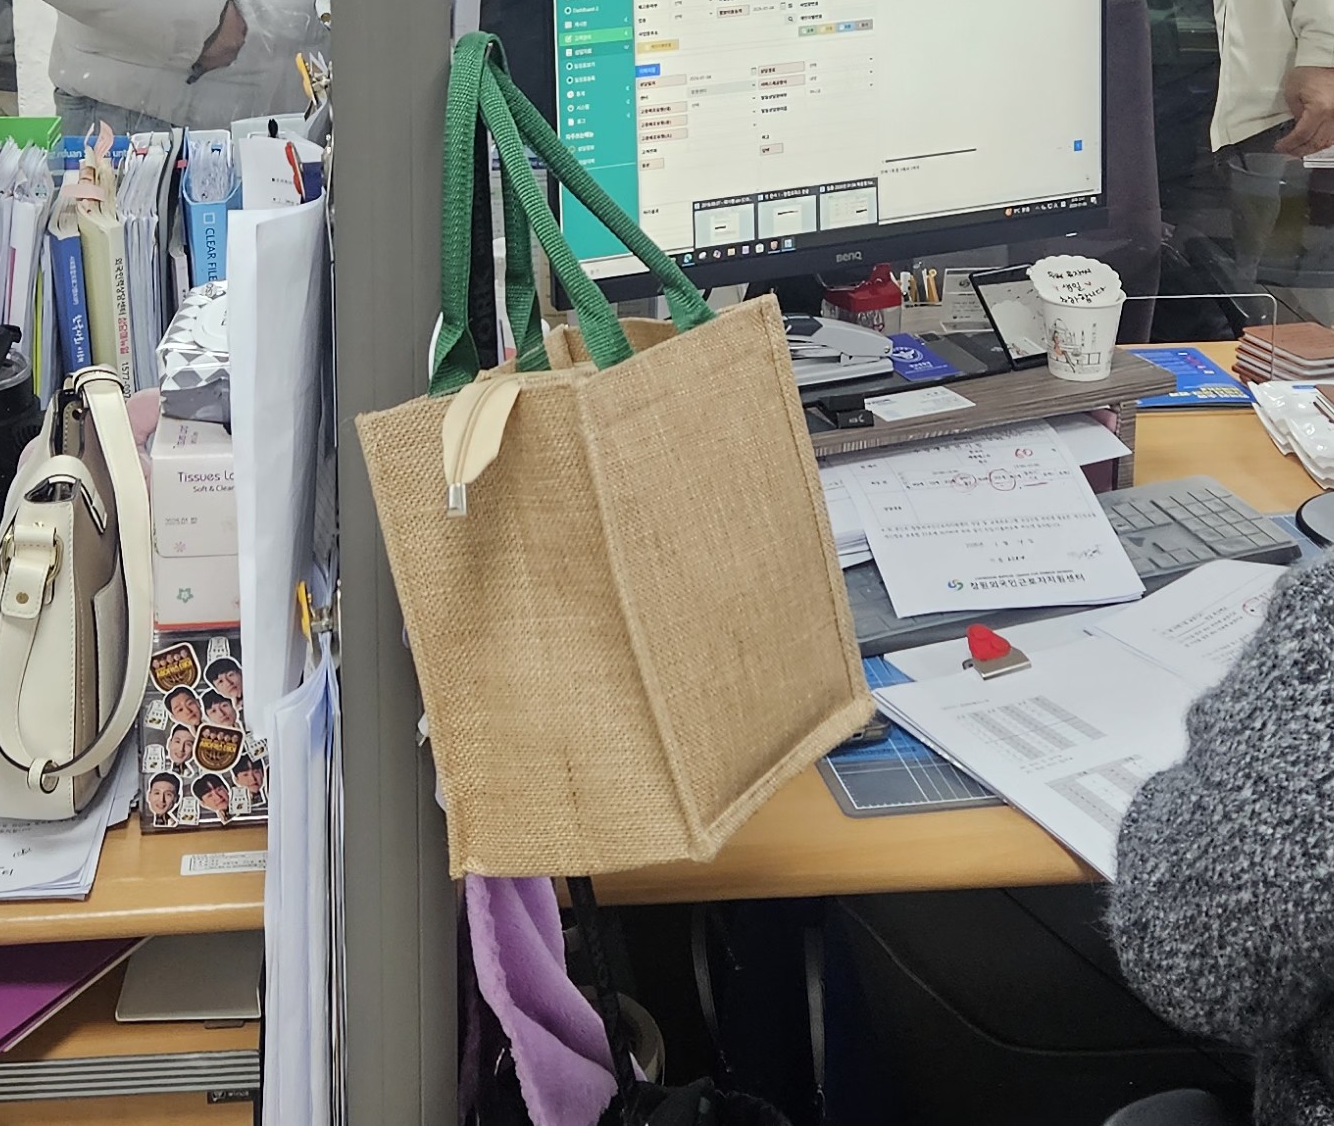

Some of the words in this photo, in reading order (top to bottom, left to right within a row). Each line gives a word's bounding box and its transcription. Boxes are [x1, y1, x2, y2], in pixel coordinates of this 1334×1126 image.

[205, 227, 216, 262] CLEAR
[835, 251, 863, 263] BenQ
[208, 262, 218, 282] FILE
[114, 258, 127, 315] 외국인력상담센터
[1062, 281, 1085, 293] 생일
[1060, 285, 1108, 304] 축하합니다
[178, 471, 221, 483] Tissues
[193, 485, 207, 493] Soft
